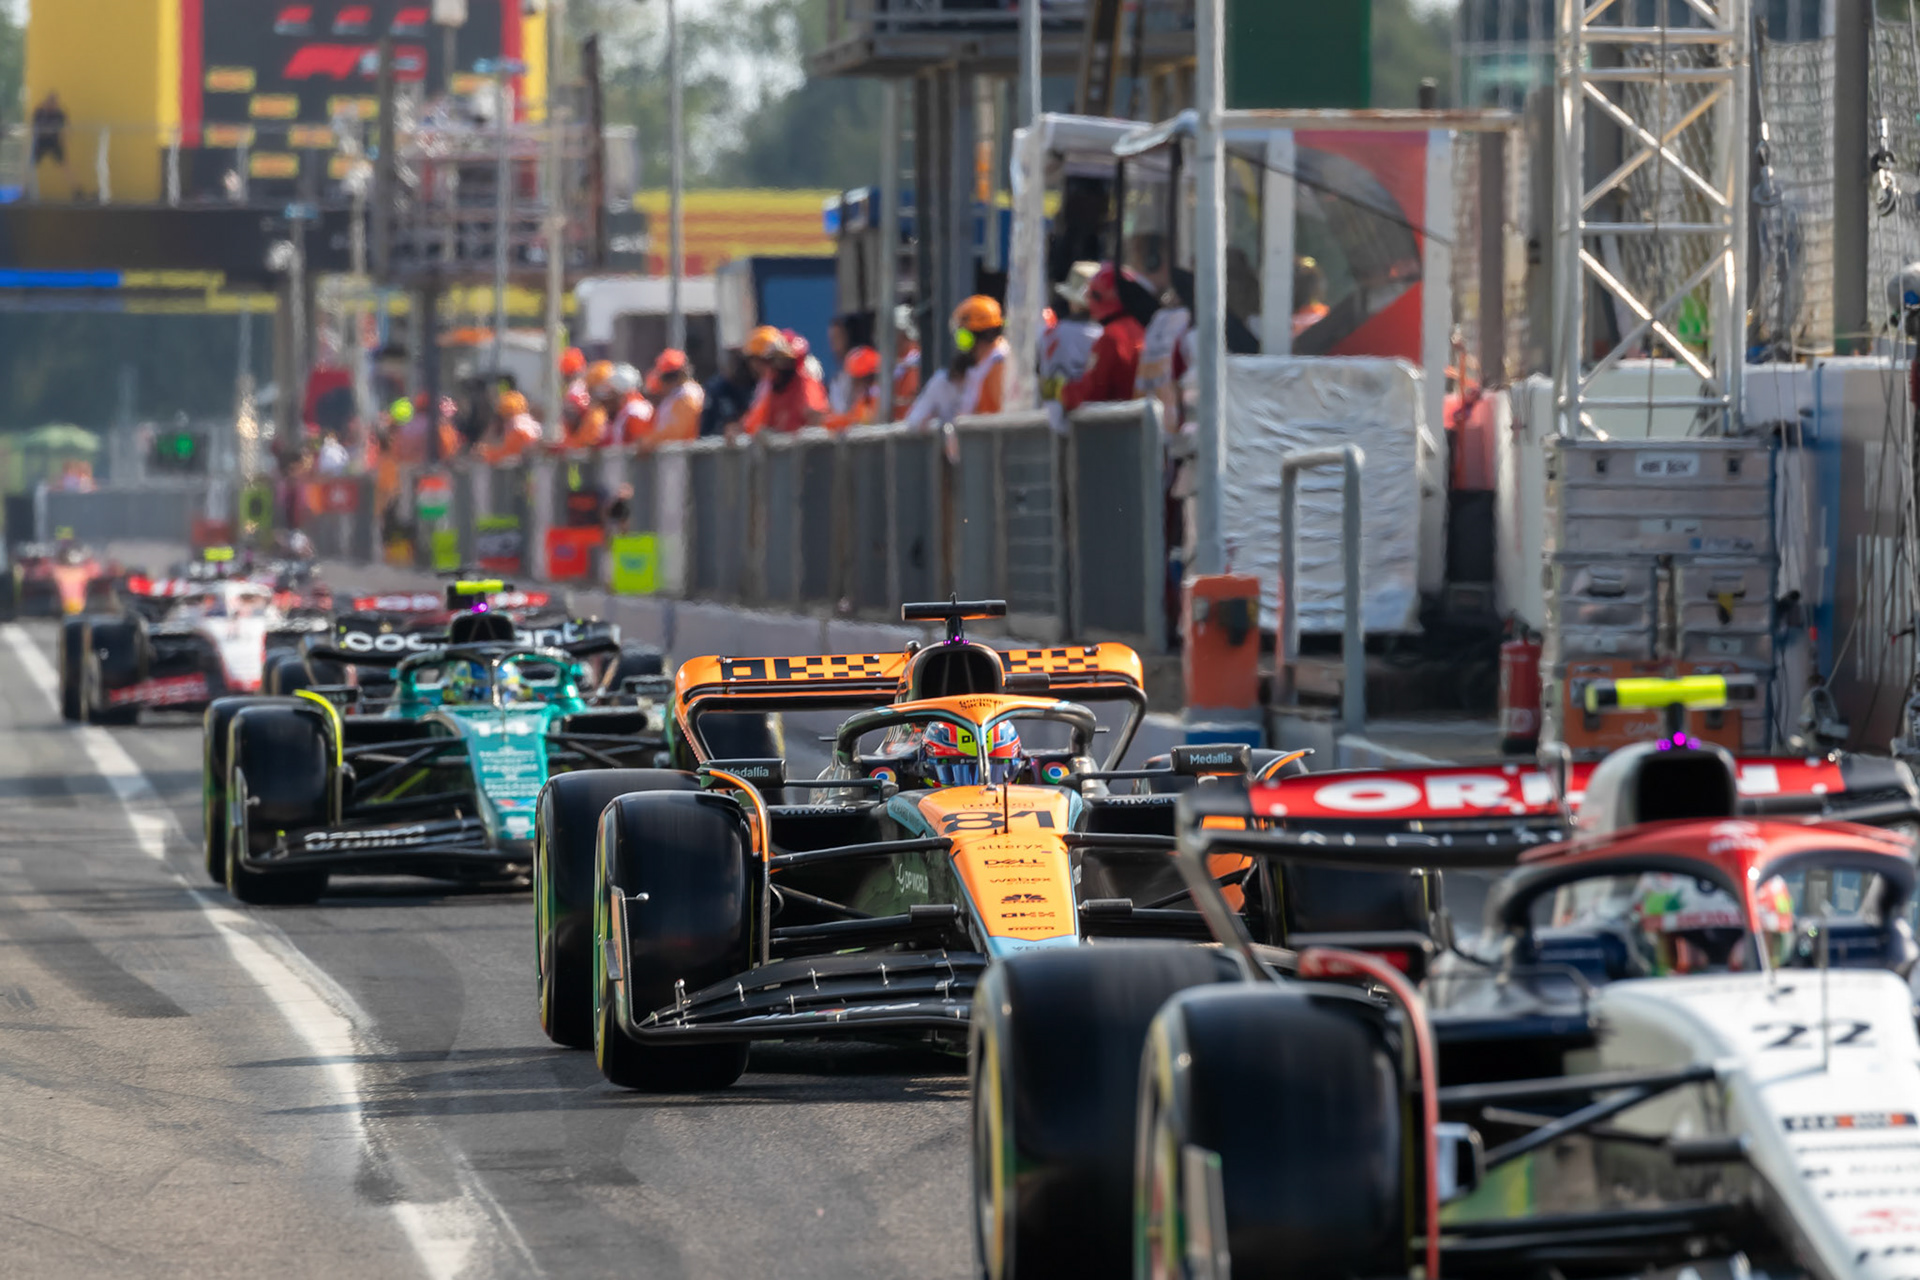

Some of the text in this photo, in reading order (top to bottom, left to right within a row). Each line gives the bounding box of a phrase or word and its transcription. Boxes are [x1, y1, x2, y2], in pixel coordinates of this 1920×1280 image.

[1190, 752, 1233, 765] Medallia
[941, 811, 1055, 834] 81
[984, 858, 1046, 866] DELL
[1001, 911, 1056, 919] OKX
[1752, 1019, 1877, 1048] 22
